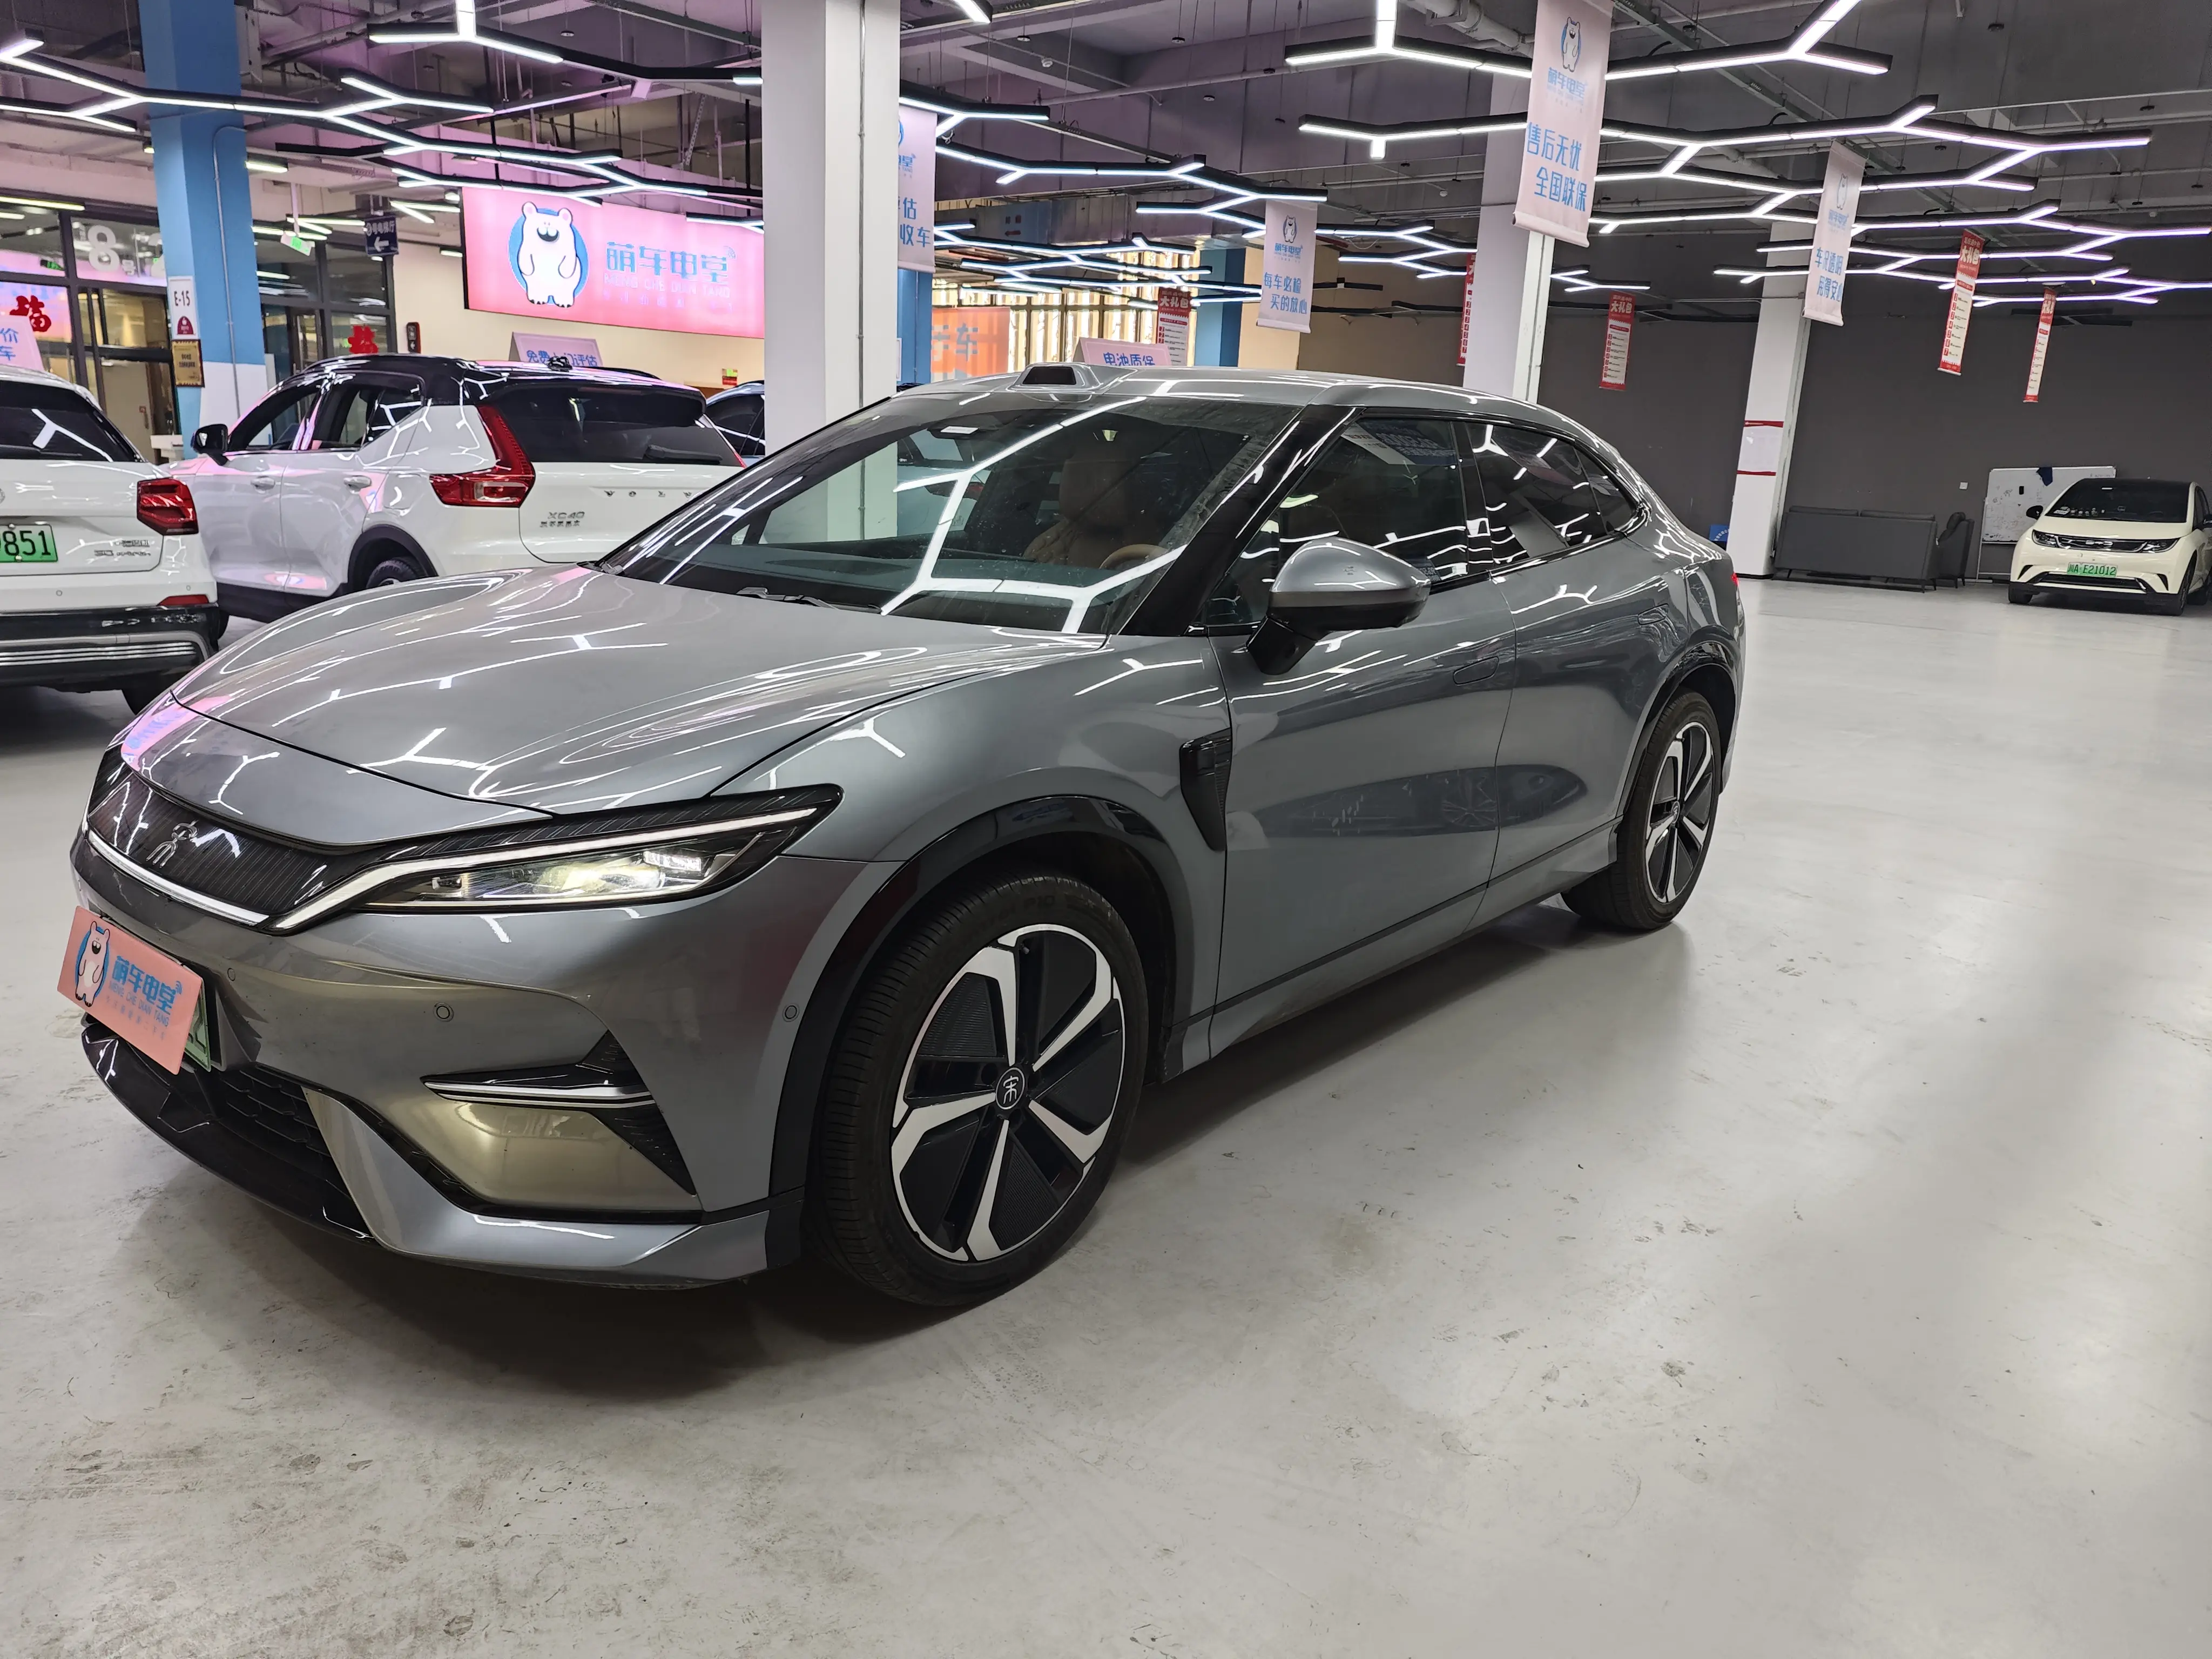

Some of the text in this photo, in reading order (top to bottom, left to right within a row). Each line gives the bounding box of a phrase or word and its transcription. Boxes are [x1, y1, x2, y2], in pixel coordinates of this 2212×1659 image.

[1526, 122, 1582, 172] 售后无忧
[1534, 166, 1588, 212] 全国联保
[898, 197, 917, 220] 估
[900, 223, 931, 248] 收车
[606, 241, 728, 285] 萌车电堂
[1814, 247, 1844, 276] 车况透明
[1264, 272, 1302, 294] 每车必检
[1816, 275, 1843, 302] 用得安心
[174, 290, 191, 306] E-15
[1161, 295, 1189, 309] 大礼包
[1270, 293, 1307, 314] 买的放心
[1610, 300, 1633, 314] 大礼包
[526, 350, 598, 367] 免费门评估
[1103, 352, 1156, 366] 电池质保
[547, 511, 585, 520] XC40
[111, 955, 176, 1015] 萌车电堂
[126, 992, 138, 1006] CHE
[139, 1001, 152, 1016] DIAN
[154, 1009, 170, 1027] TANG
